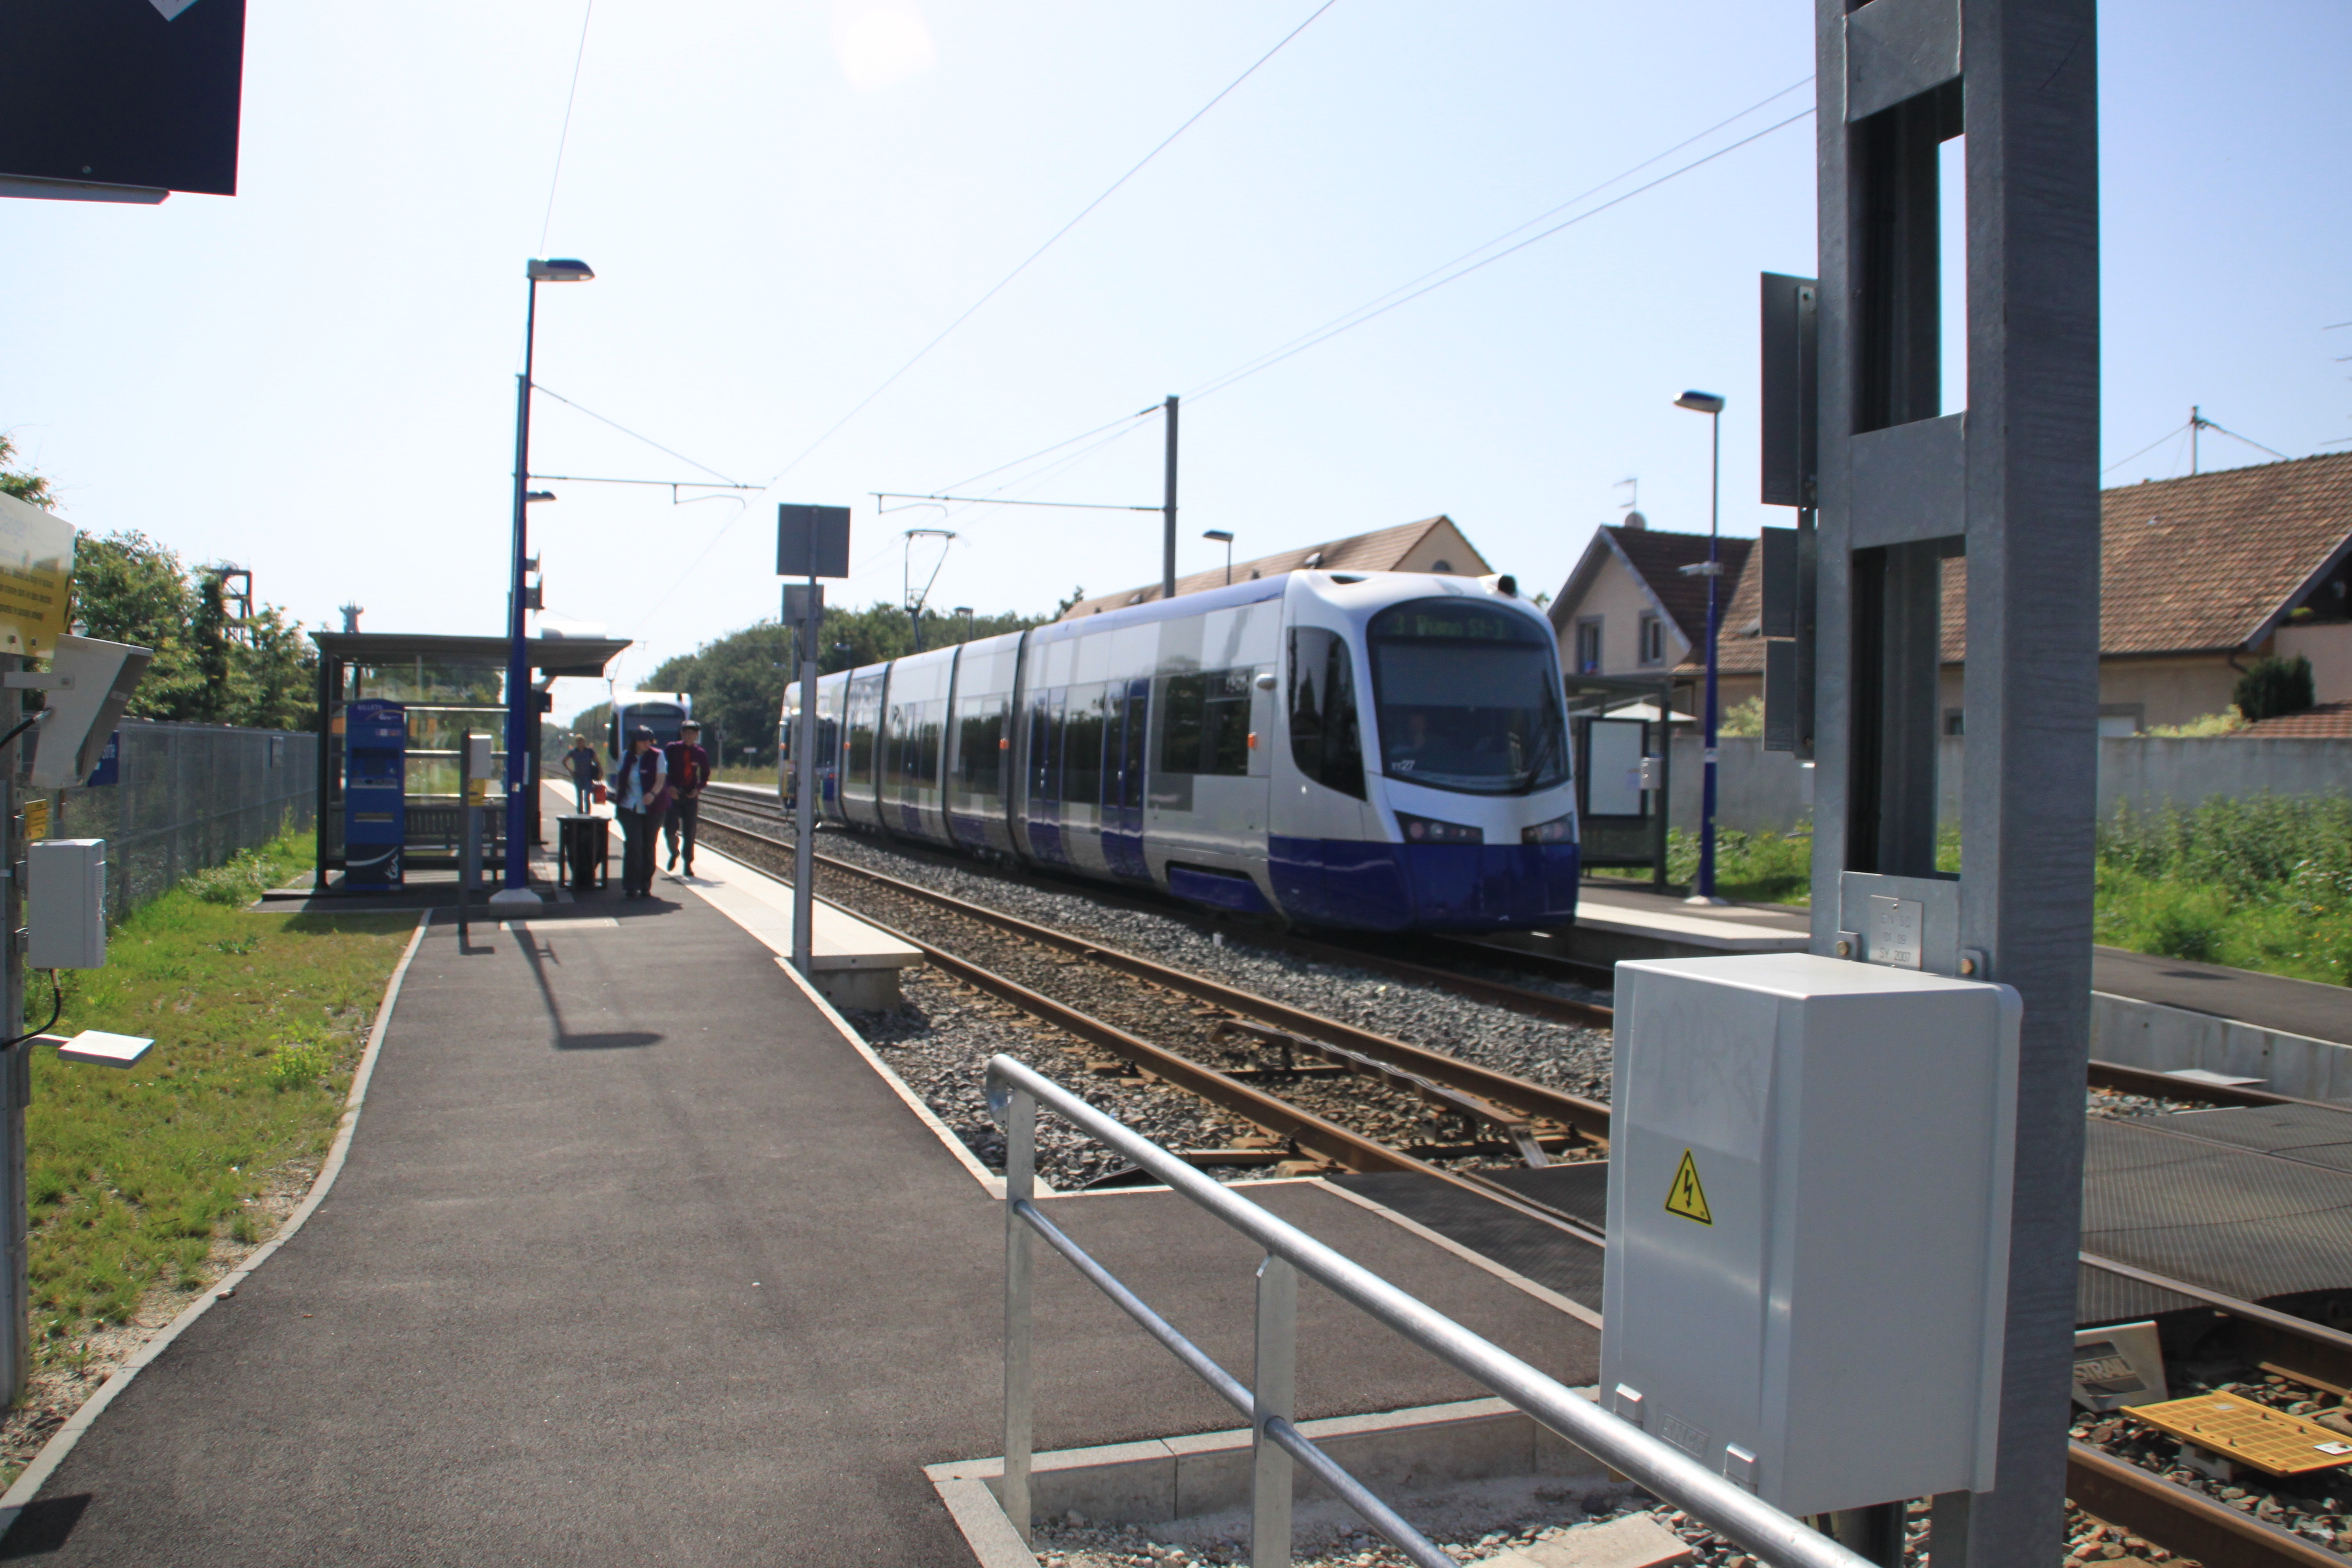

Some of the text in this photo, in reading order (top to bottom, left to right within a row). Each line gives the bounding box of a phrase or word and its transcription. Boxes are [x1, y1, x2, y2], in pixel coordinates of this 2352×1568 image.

[357, 703, 383, 711] BILLETS
[1894, 950, 1911, 962] 2007
[2073, 1357, 2134, 1383] STRAIL
